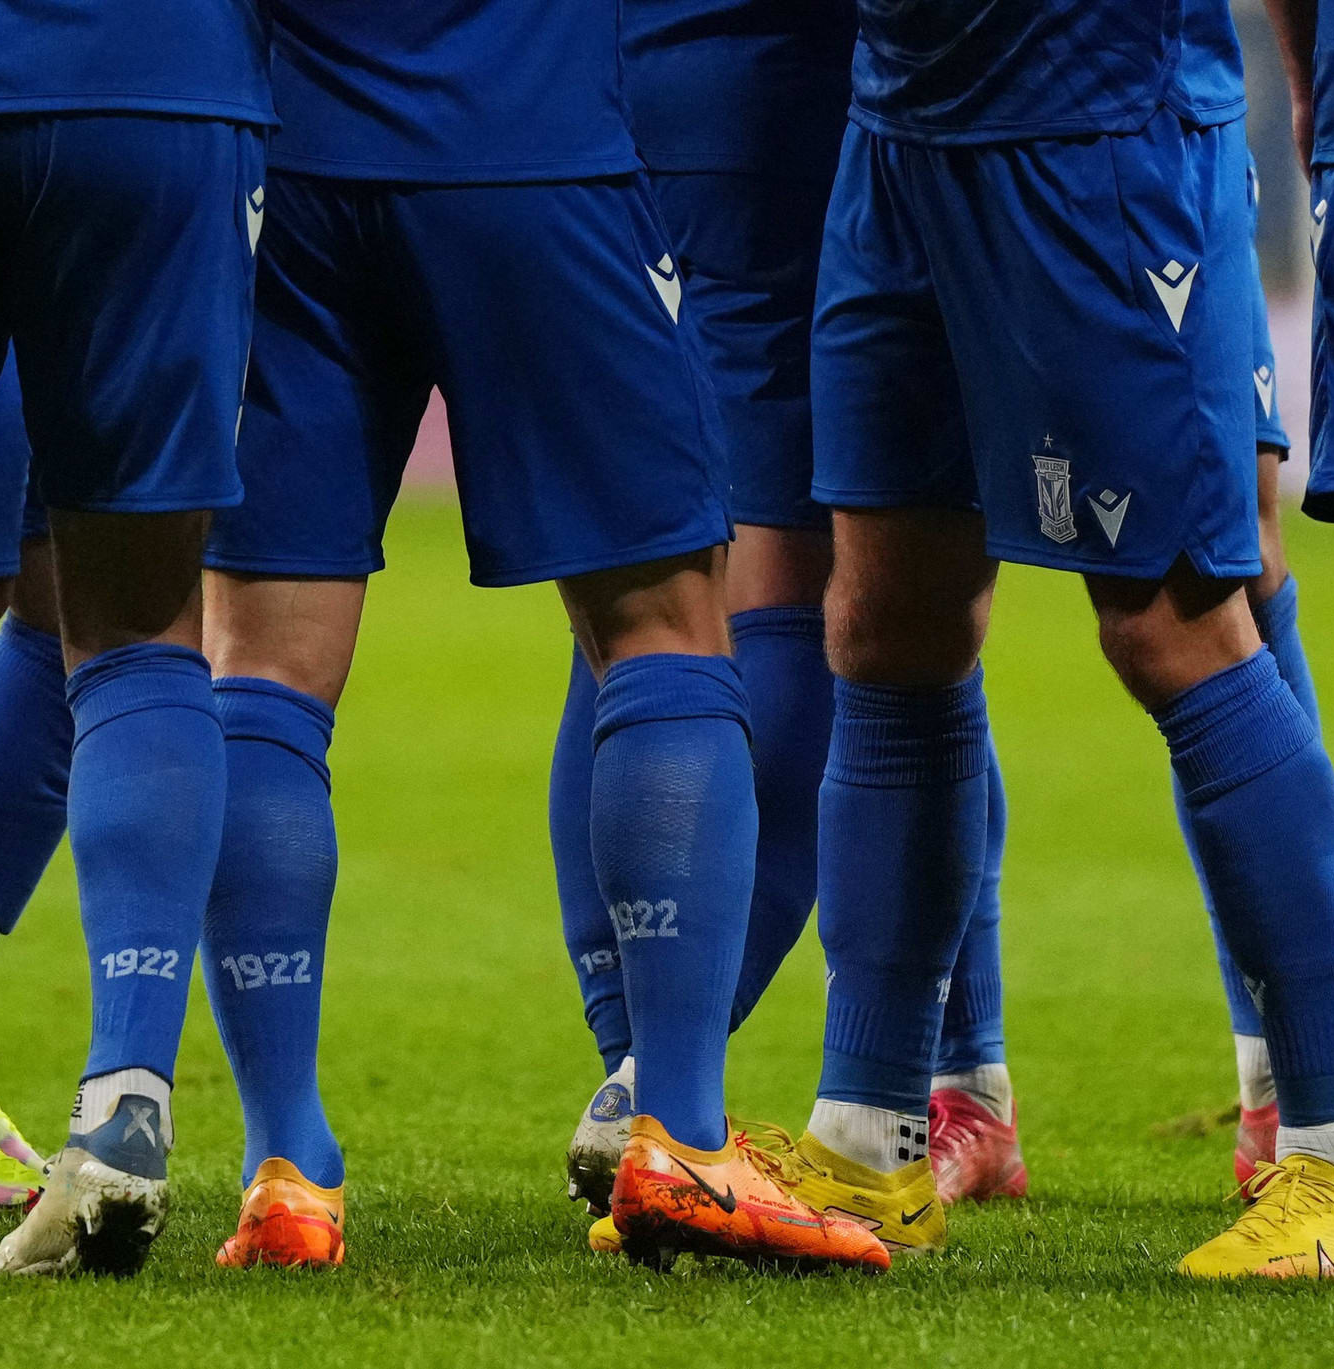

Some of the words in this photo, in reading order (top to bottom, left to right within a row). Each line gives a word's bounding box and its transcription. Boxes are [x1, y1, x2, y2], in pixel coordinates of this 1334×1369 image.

[608, 898, 679, 942] 1922
[100, 947, 180, 981] 1922
[221, 949, 312, 991] 1922
